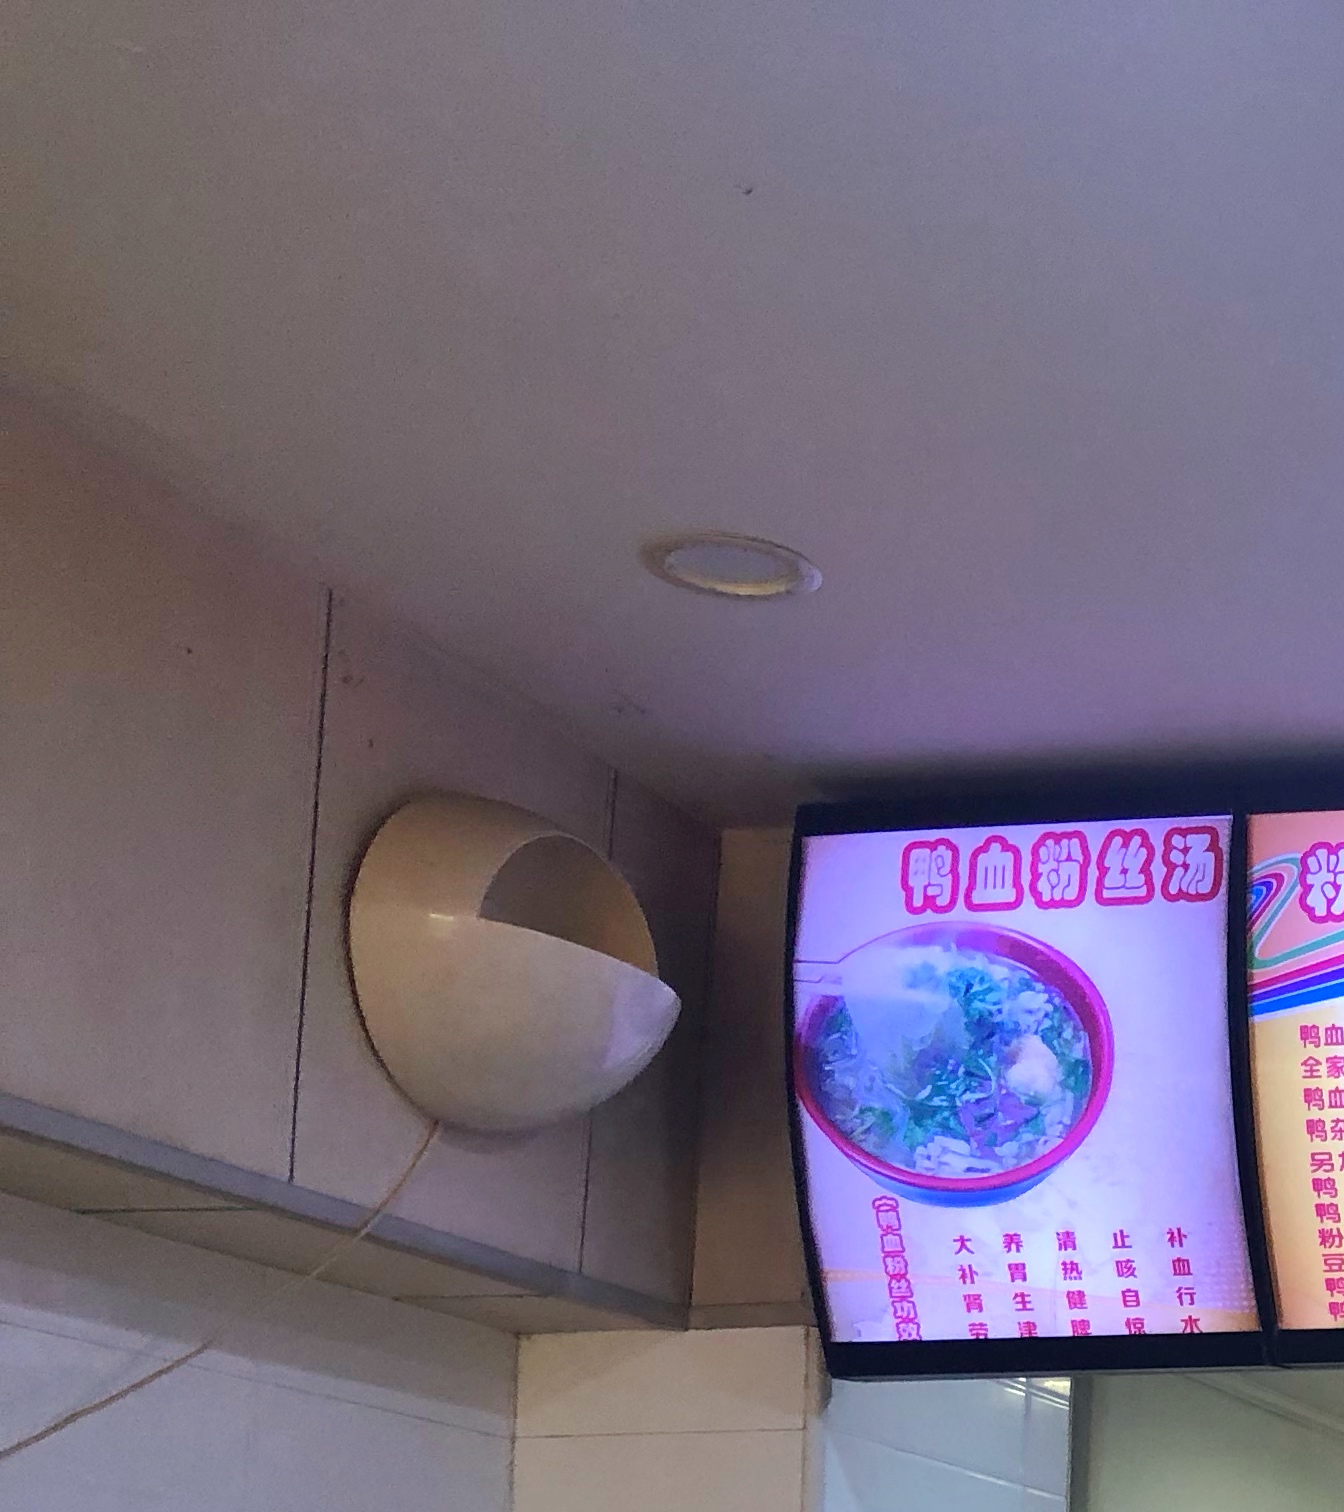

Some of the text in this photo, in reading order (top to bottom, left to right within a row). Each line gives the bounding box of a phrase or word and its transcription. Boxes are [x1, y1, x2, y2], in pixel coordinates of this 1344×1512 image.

[902, 826, 1223, 915] 鸭血粉丝汤
